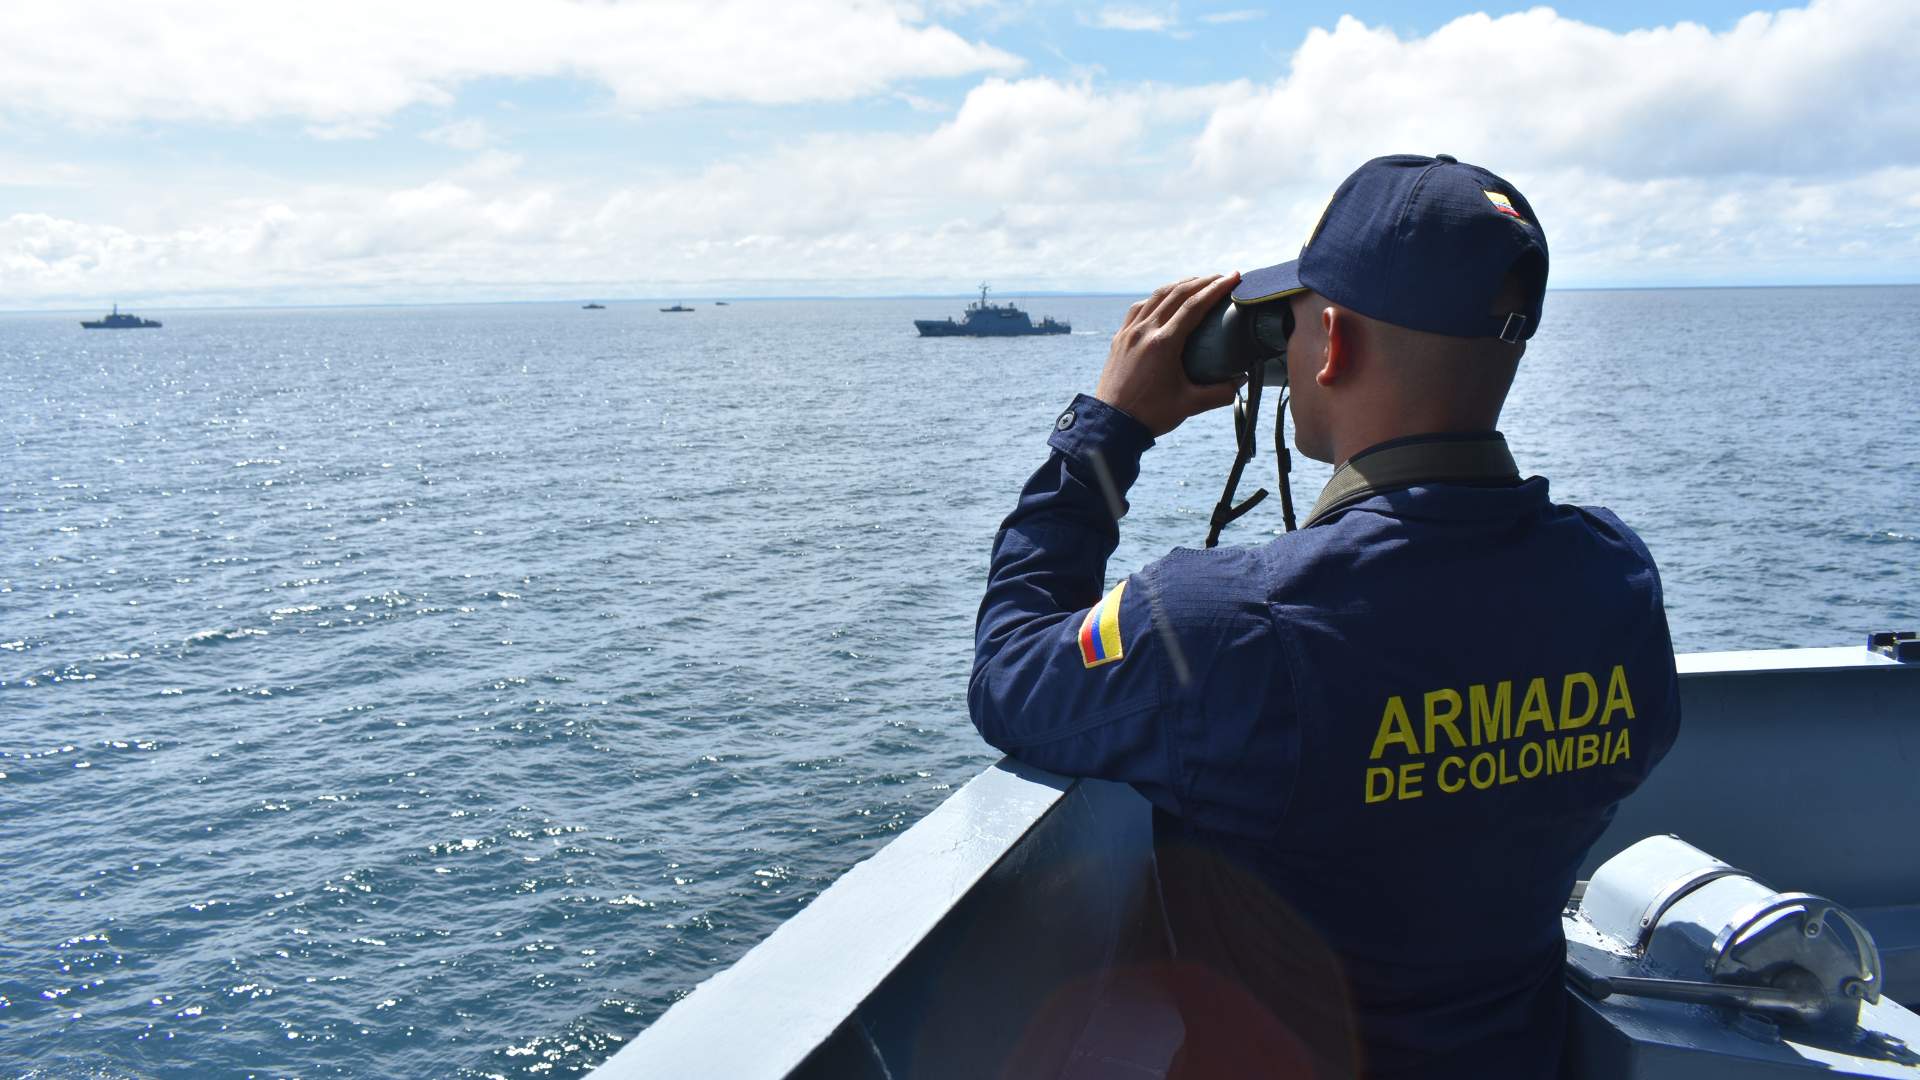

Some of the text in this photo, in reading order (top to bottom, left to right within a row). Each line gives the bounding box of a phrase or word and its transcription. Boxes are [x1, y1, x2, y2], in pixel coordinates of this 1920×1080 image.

[1369, 665, 1635, 759] ARMADA
[1365, 728, 1631, 803] DE COLOMBIA
